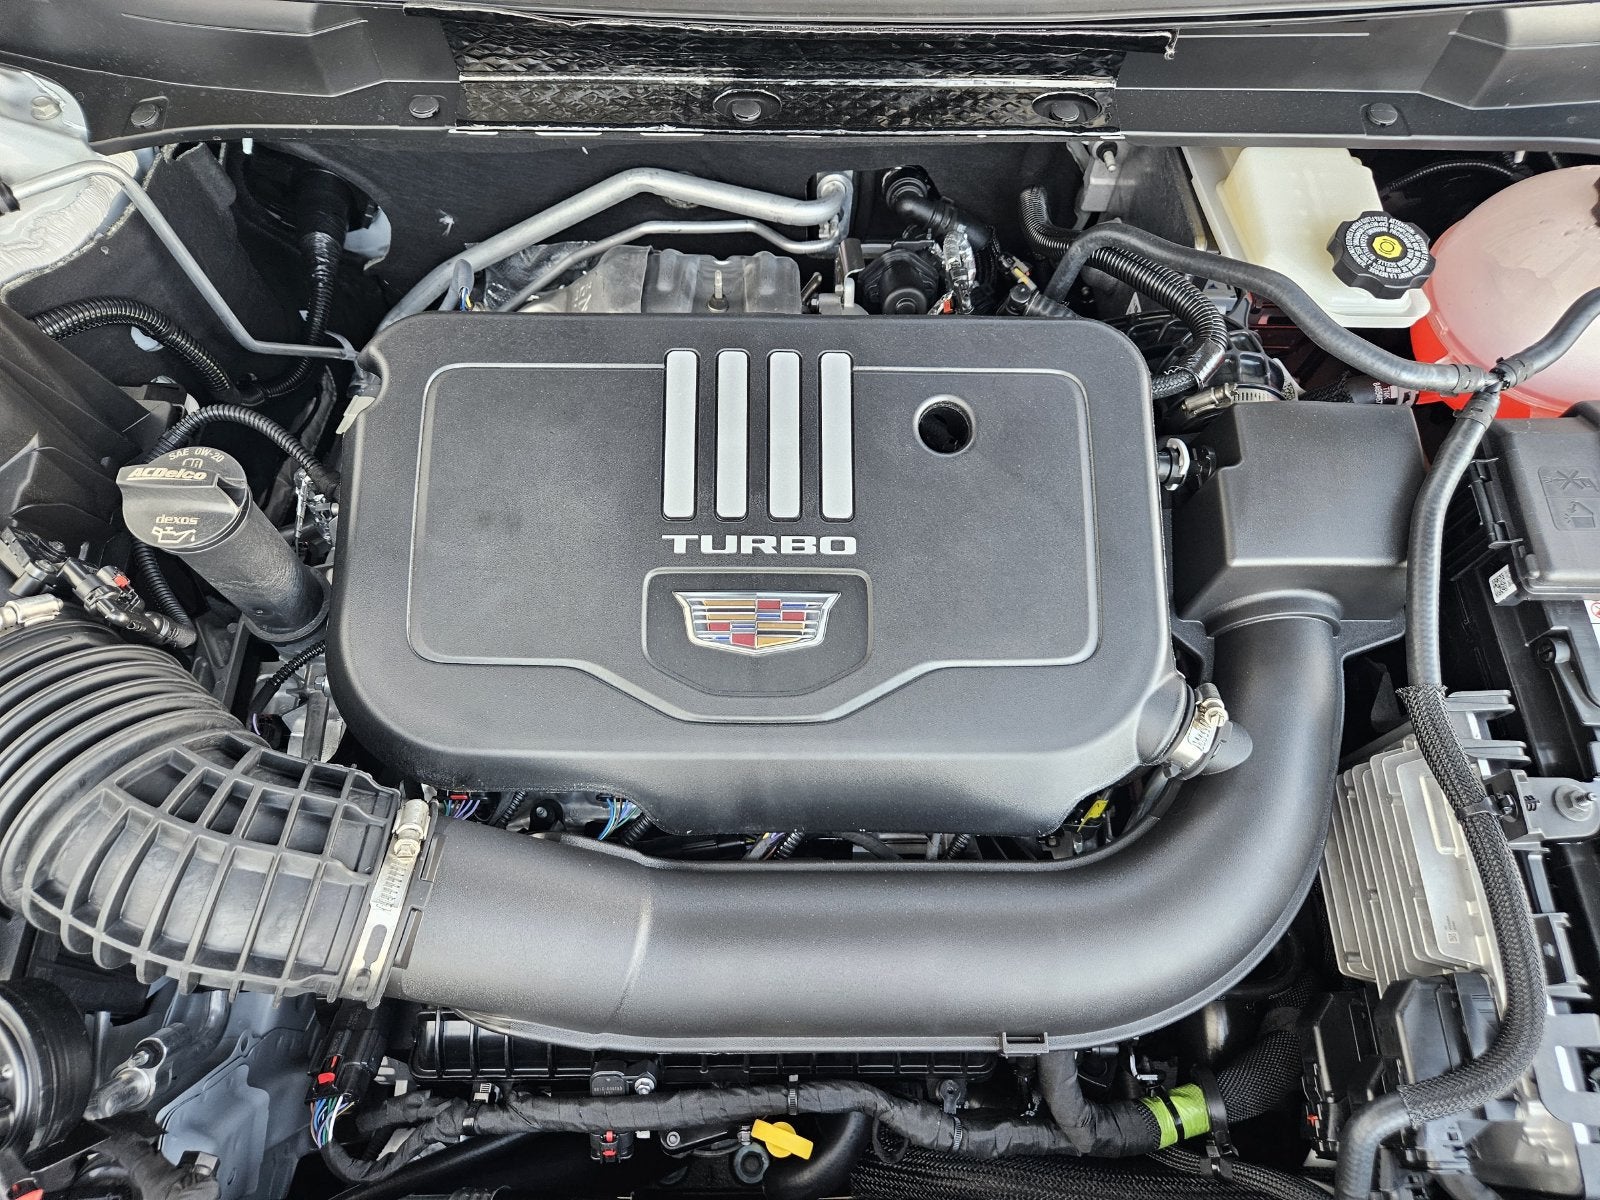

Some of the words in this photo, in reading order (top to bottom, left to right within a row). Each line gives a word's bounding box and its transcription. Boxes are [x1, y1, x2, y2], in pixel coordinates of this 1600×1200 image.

[169, 449, 190, 460] SAE
[195, 448, 225, 462] 0W-20
[127, 468, 207, 480] ACDelco
[155, 514, 200, 524] dexos
[662, 535, 857, 554] TURBO
